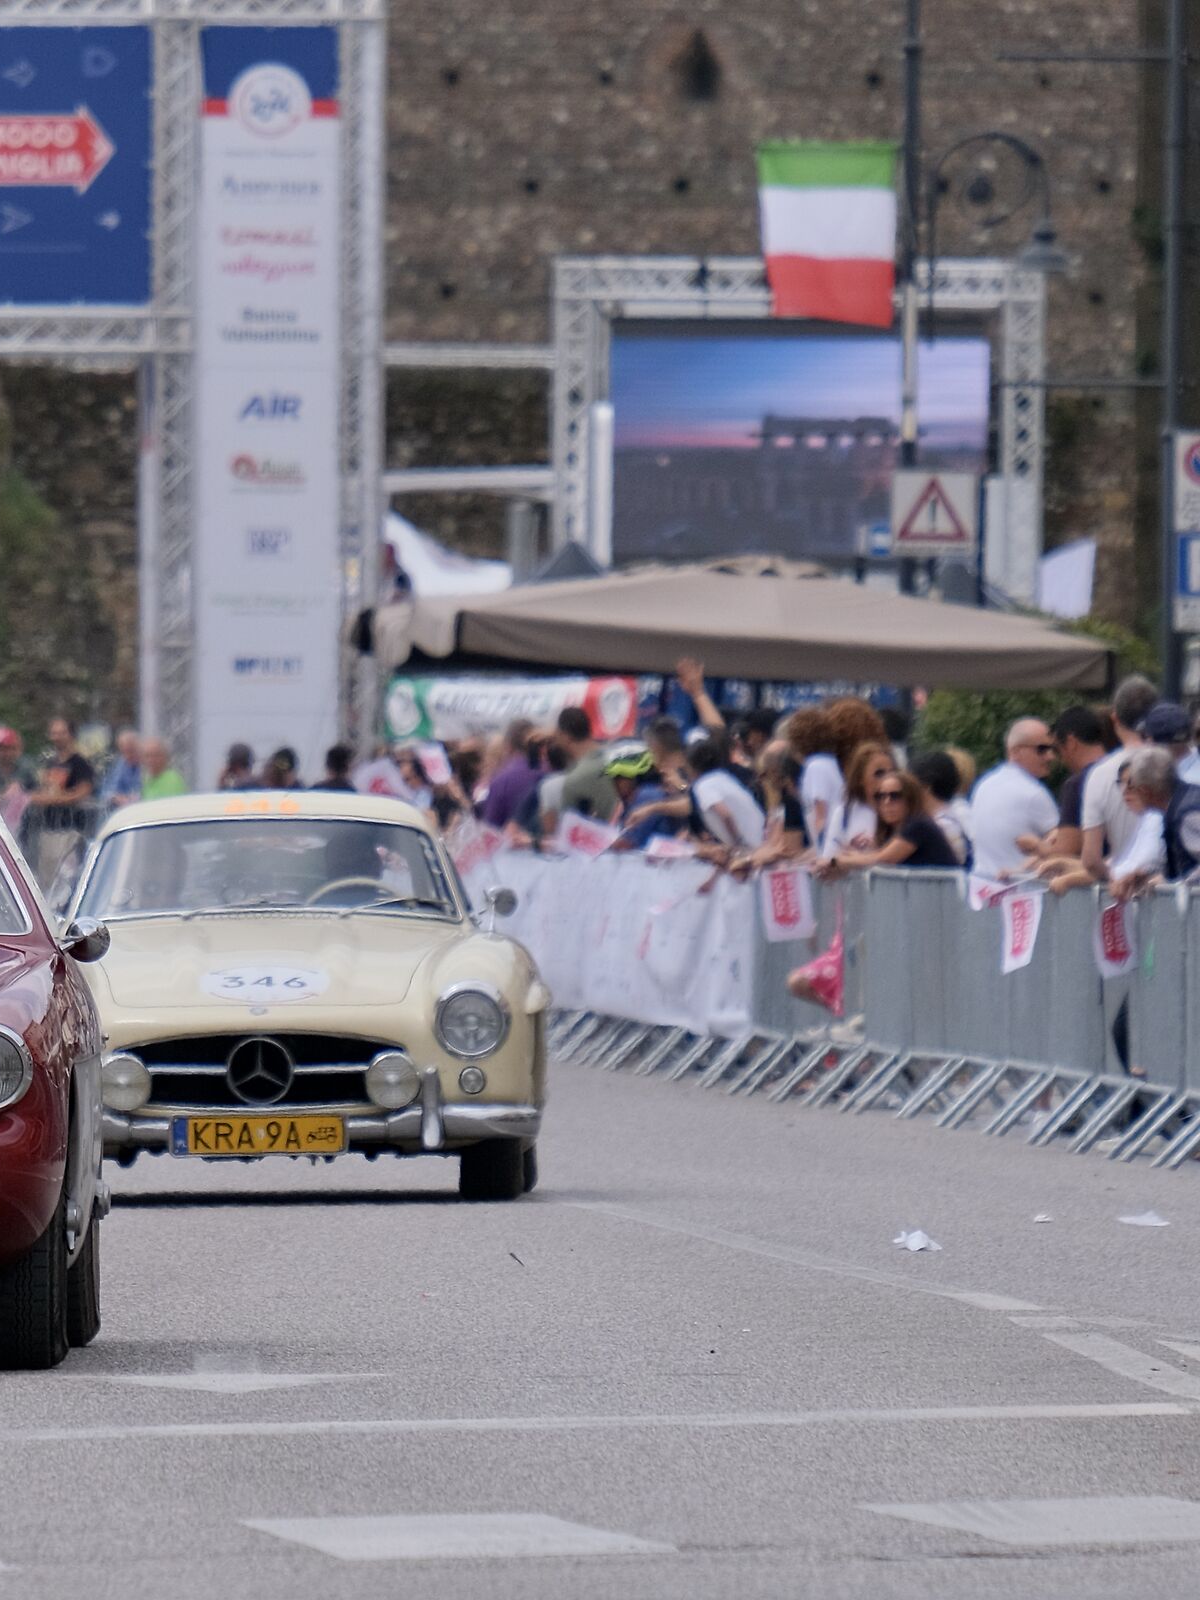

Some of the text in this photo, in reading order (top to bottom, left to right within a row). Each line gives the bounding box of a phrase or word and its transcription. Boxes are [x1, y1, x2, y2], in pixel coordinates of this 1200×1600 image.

[221, 976, 309, 989] 346
[192, 1120, 301, 1150] KRA 9A
